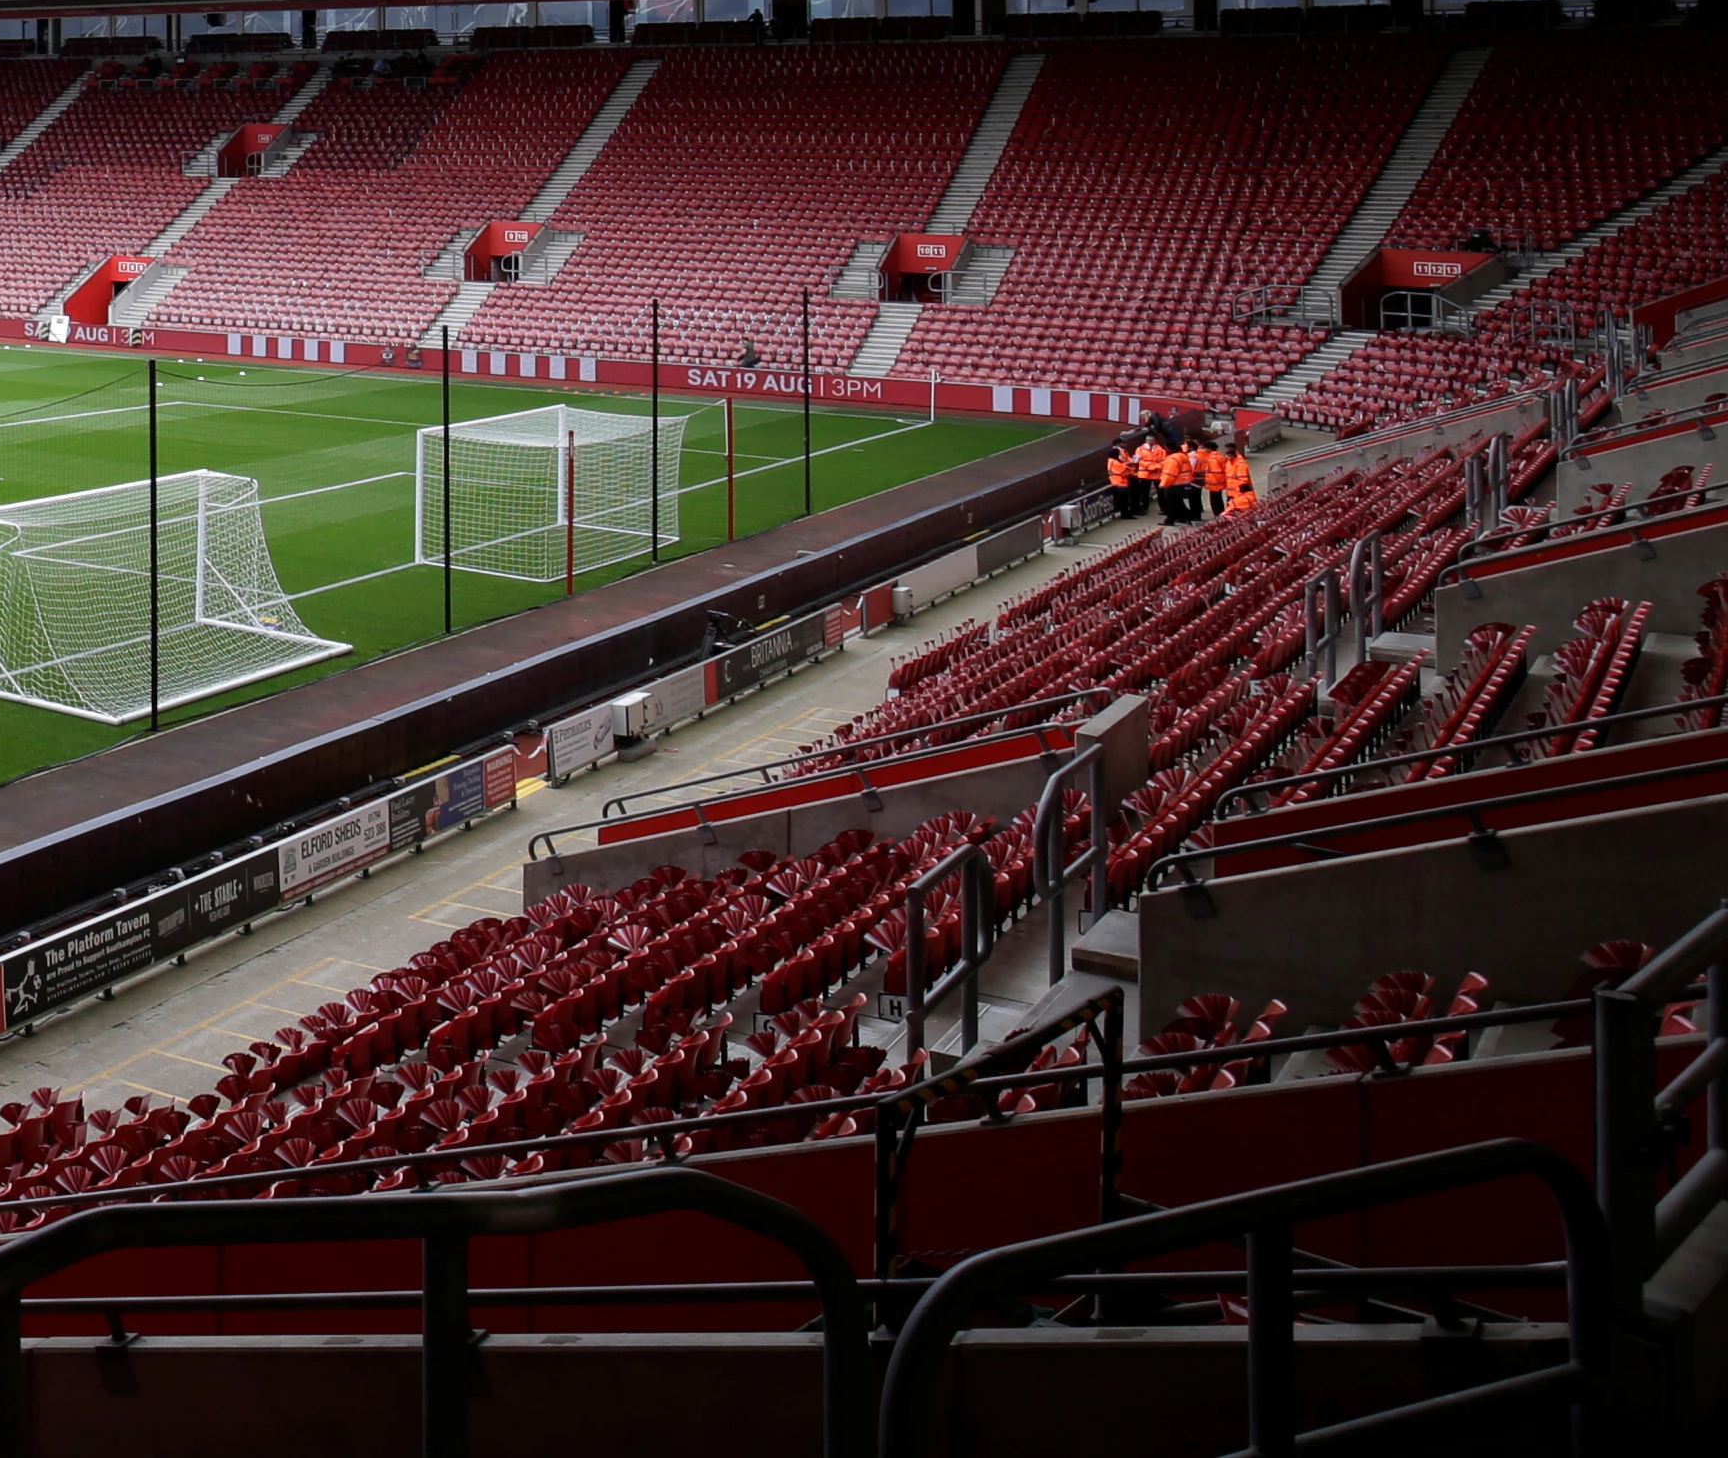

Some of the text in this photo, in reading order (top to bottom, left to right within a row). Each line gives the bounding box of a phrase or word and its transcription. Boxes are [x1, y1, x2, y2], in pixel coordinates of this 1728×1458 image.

[74, 326, 109, 342] AUG
[687, 368, 882, 398] SAT 19 AUG 3PM
[750, 630, 793, 668] BRITANNIA
[301, 830, 333, 860] ELFORD
[334, 818, 362, 846] SHEDS
[199, 893, 212, 914] THE
[214, 878, 238, 908] STABLE
[45, 912, 150, 967] The Platform Tavern
[57, 962, 75, 976] Proud
[82, 948, 105, 965] Support
[889, 999, 902, 1017] H
